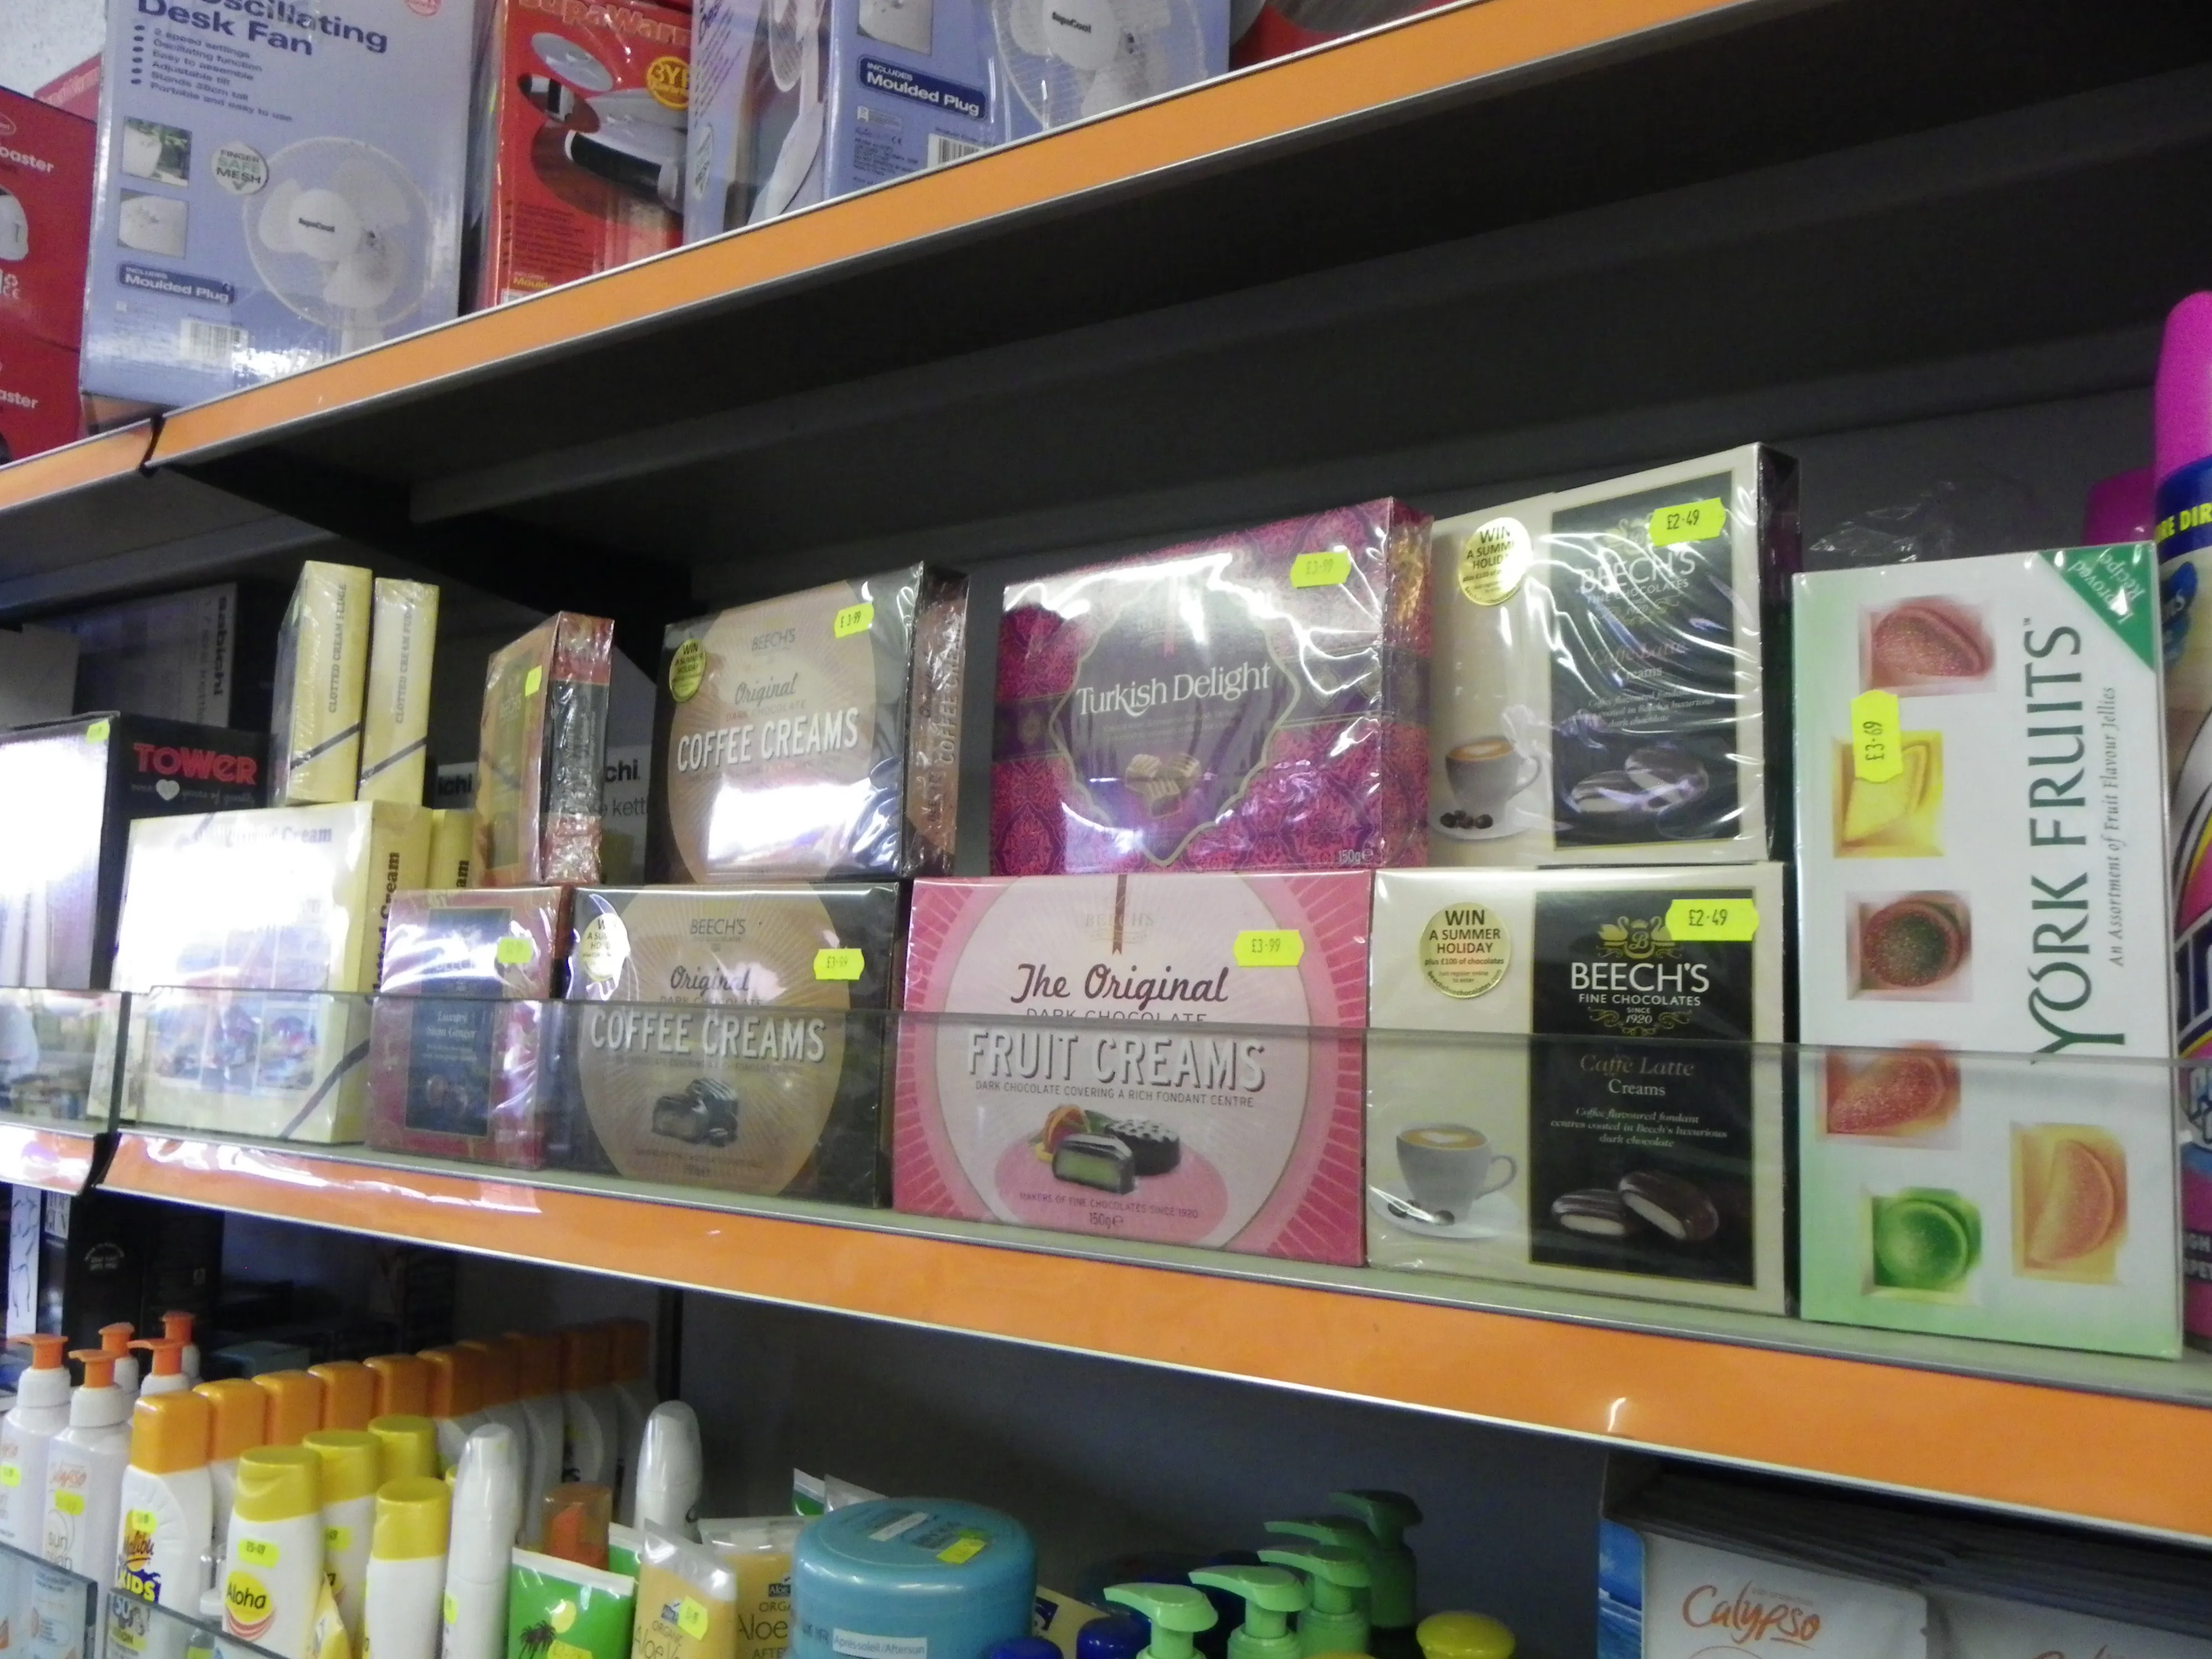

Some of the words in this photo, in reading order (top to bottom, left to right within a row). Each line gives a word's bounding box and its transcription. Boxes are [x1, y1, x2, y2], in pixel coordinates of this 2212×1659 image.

[138, 0, 237, 36] Desk
[248, 20, 313, 56] Fan
[200, 0, 387, 54] scillating
[867, 61, 913, 81] INCLUDES
[867, 72, 940, 103] Moulded
[943, 93, 979, 117] Plug
[0, 145, 54, 174] oaster
[220, 149, 260, 163] FINGER
[216, 166, 262, 184] MESH
[125, 273, 192, 295] Moulded
[196, 286, 229, 305] Plug
[0, 389, 39, 409] aster
[2179, 502, 2212, 531] DIR
[1467, 550, 1474, 560] A
[332, 623, 343, 661] CREAM
[400, 637, 411, 674] CREAM
[683, 642, 699, 655] WIN
[328, 664, 341, 713] CLOTTED
[395, 675, 407, 724] CLOTTED
[734, 671, 799, 707] Original
[1077, 678, 1167, 717] Turkish
[1172, 661, 1271, 701] Delight
[677, 724, 754, 773] COFFEE
[760, 707, 860, 760] CREAMS
[940, 695, 958, 765] COFFEE
[2099, 735, 2120, 792] Flavour
[2103, 796, 2122, 833] Fruit
[2101, 834, 2127, 852] of
[2105, 855, 2124, 940] Assortment
[690, 917, 747, 936] BEECH'S
[1444, 909, 1486, 926] WIN
[1428, 930, 1439, 941] A
[1442, 928, 1501, 941] SUMMER
[1437, 942, 1494, 954] HOLIDAY
[1424, 958, 1439, 966] plus
[1441, 957, 1458, 966] £100
[2027, 872, 2126, 1066] YORK
[2108, 945, 2124, 967] An
[1010, 963, 1071, 1004] The
[1084, 963, 1230, 1011] Original
[1571, 962, 1710, 993] BEECH'S
[1578, 993, 1607, 1004] FINE
[1611, 993, 1702, 1006] CHOCOLATES
[1625, 1014, 1653, 1024] 1920
[448, 1027, 478, 1040] Ginger
[589, 1009, 693, 1056] COFFEE
[702, 1011, 827, 1064] CREAMS
[968, 1030, 1079, 1082] FRUIT
[1093, 1036, 1266, 1093] CREAMS
[1639, 1056, 1695, 1077] Latte
[975, 1080, 1001, 1091] DARK
[1003, 1082, 1061, 1096] CHOCOLATE
[1063, 1086, 1115, 1099] COVERING
[1117, 1089, 1125, 1099] A
[1128, 1090, 1154, 1102] RICH
[1156, 1091, 1207, 1105] FONDANT
[1210, 1094, 1255, 1108] CENTRE
[1608, 1078, 1666, 1097] Creams
[1550, 1119, 1586, 1129] centres
[1588, 1122, 1621, 1132] coated
[1623, 1124, 1634, 1133] in
[1636, 1123, 1674, 1135] Beech's
[1675, 1126, 1729, 1139] luxurious
[1575, 1107, 1605, 1119] Coffee
[1606, 1108, 1657, 1121] flavoured
[1658, 1111, 1700, 1124] fondant
[1598, 1133, 1624, 1145] dark
[1625, 1136, 1676, 1148] chocolate
[1019, 1192, 1053, 1203] MAKERS
[1054, 1195, 1067, 1204] OF
[1068, 1196, 1087, 1208] FINE
[1089, 1198, 1147, 1214] CHOCOLATES
[1149, 1204, 1176, 1217] SINCE
[117, 1569, 156, 1603] KIDS
[226, 1582, 266, 1610] Aloha
[1682, 1579, 1820, 1645] Calypso
[737, 1613, 789, 1641] Aloe
